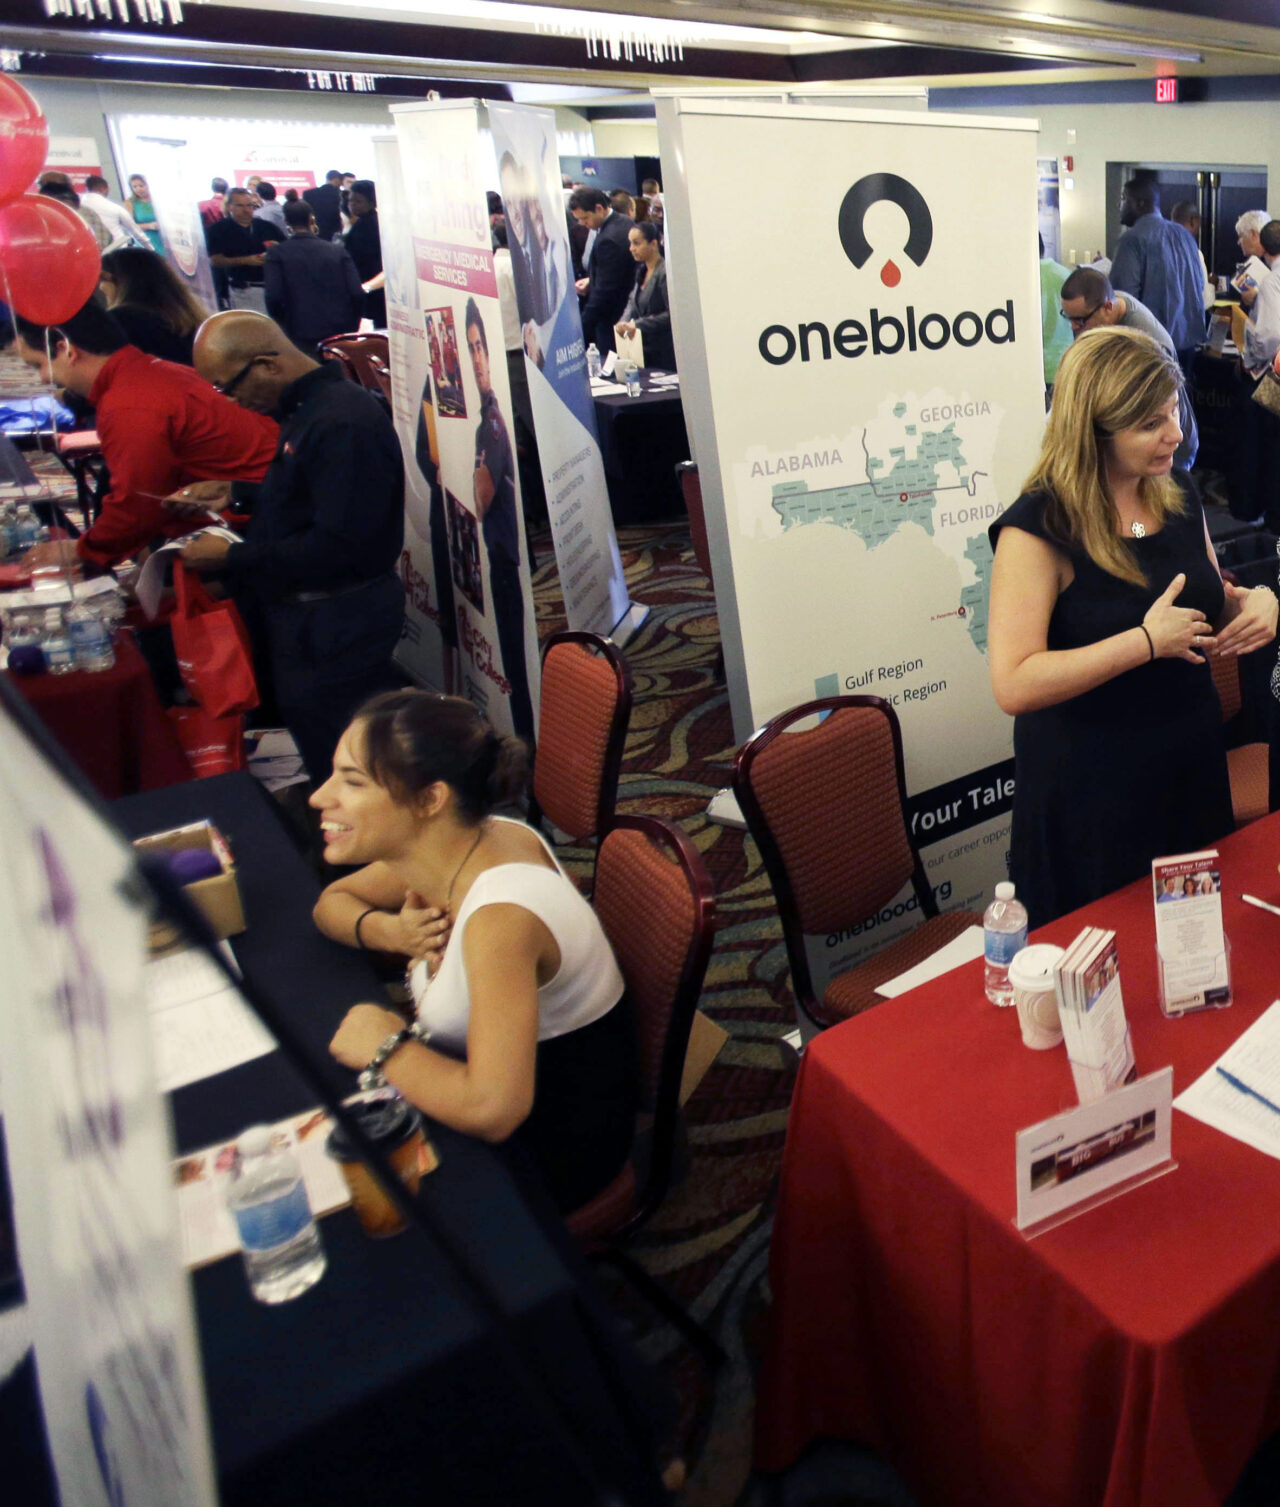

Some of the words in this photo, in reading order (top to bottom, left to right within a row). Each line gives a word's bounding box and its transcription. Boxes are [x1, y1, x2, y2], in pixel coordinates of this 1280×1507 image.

[1156, 79, 1176, 102] EXIT
[453, 250, 491, 272] MEDICAL
[433, 265, 468, 286] SERVICES
[758, 299, 1015, 365] oneblood
[920, 400, 991, 423] GEORGIA
[750, 448, 843, 478] ALABAMA
[940, 502, 1005, 527] FLORIDA
[471, 628, 493, 661] City
[845, 668, 875, 690] Gulf
[878, 658, 923, 680] Region
[903, 680, 947, 702] Region
[968, 778, 1015, 811] Tale
[927, 853, 945, 869] our
[948, 837, 980, 861] career
[1160, 865, 1179, 875] Share
[1180, 863, 1194, 872] Your
[1194, 859, 1214, 869] Talent
